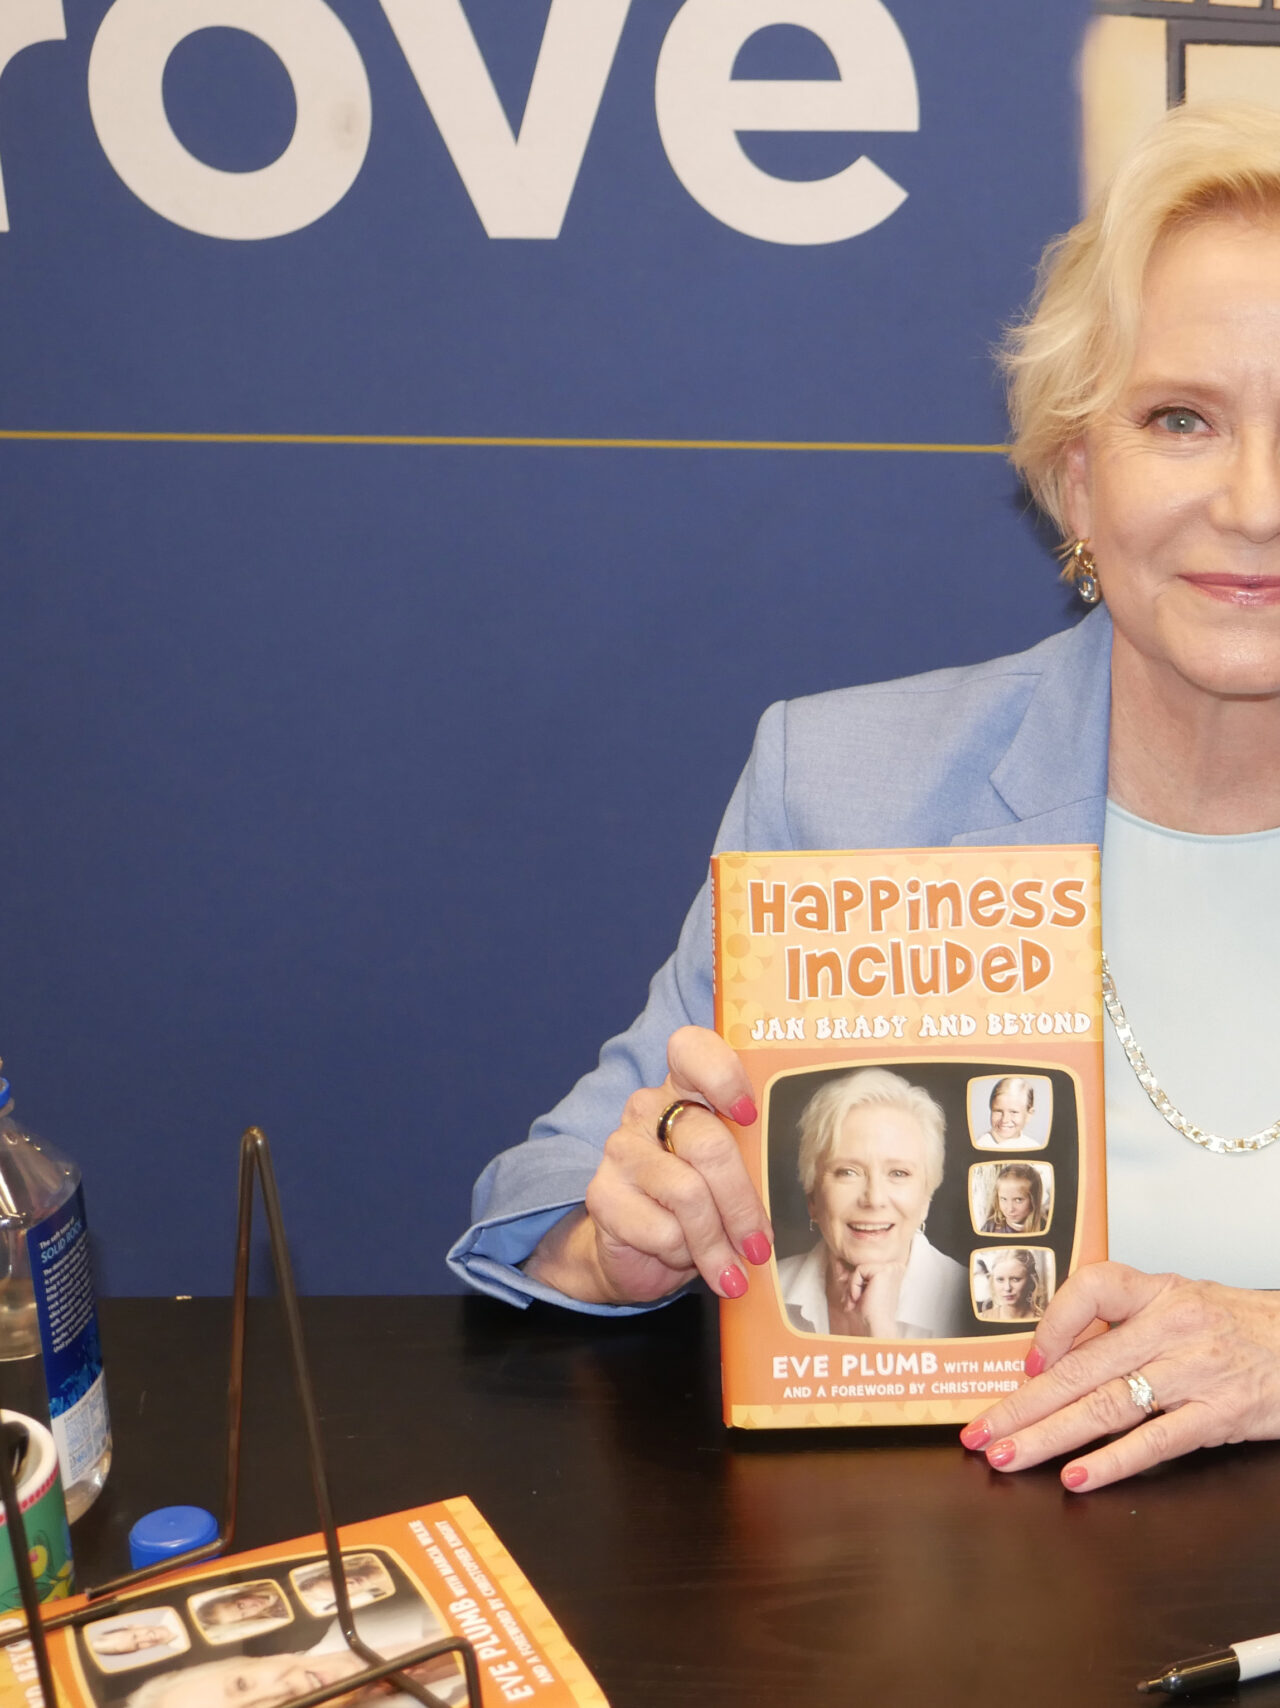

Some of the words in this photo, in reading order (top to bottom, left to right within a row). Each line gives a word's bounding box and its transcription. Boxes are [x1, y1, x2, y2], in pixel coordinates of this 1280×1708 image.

[0, 0, 921, 245] ove
[750, 1017, 805, 1041] JAN
[815, 1015, 909, 1040] BRADY
[918, 1013, 977, 1037] AND
[986, 1012, 1091, 1036] BEYOND
[41, 1238, 66, 1263] SOLID
[772, 1355, 829, 1379] EVE
[841, 1351, 938, 1377] PLUMB
[944, 1361, 978, 1373] WITH
[983, 1360, 1025, 1373] MARCI
[783, 1386, 812, 1398] AND
[816, 1385, 827, 1398] A
[831, 1383, 905, 1397] FOREWORD
[909, 1382, 926, 1395] BY
[931, 1380, 1019, 1394] CHRISTOPHER
[487, 1598, 505, 1610] BY
[449, 1597, 507, 1661] PLUMB
[496, 1610, 535, 1657] FOREWORD
[526, 1655, 541, 1665] A
[531, 1664, 554, 1684] AND
[488, 1660, 535, 1701] EVE
